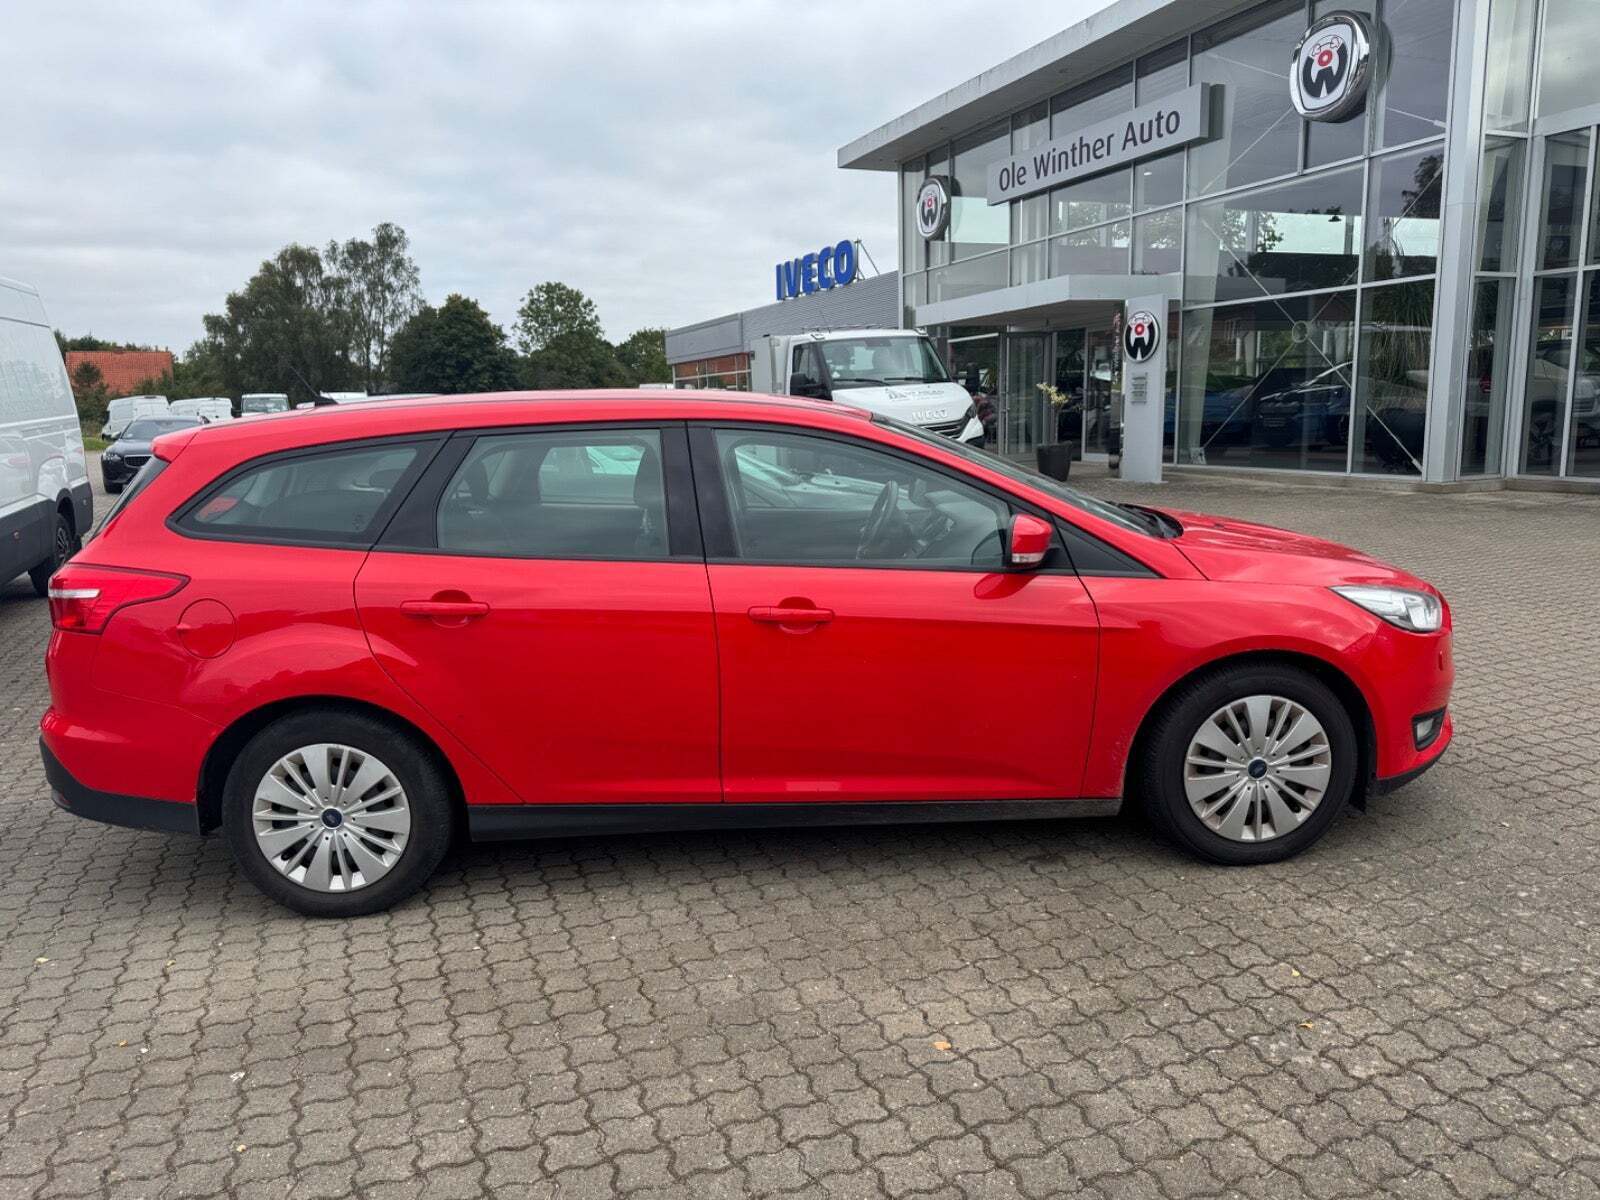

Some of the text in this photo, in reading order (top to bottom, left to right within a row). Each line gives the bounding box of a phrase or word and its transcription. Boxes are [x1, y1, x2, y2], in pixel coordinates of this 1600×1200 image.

[999, 110, 1180, 191] Ole Winther Auto
[775, 239, 856, 301] IVECO
[911, 408, 949, 421] IVECO
